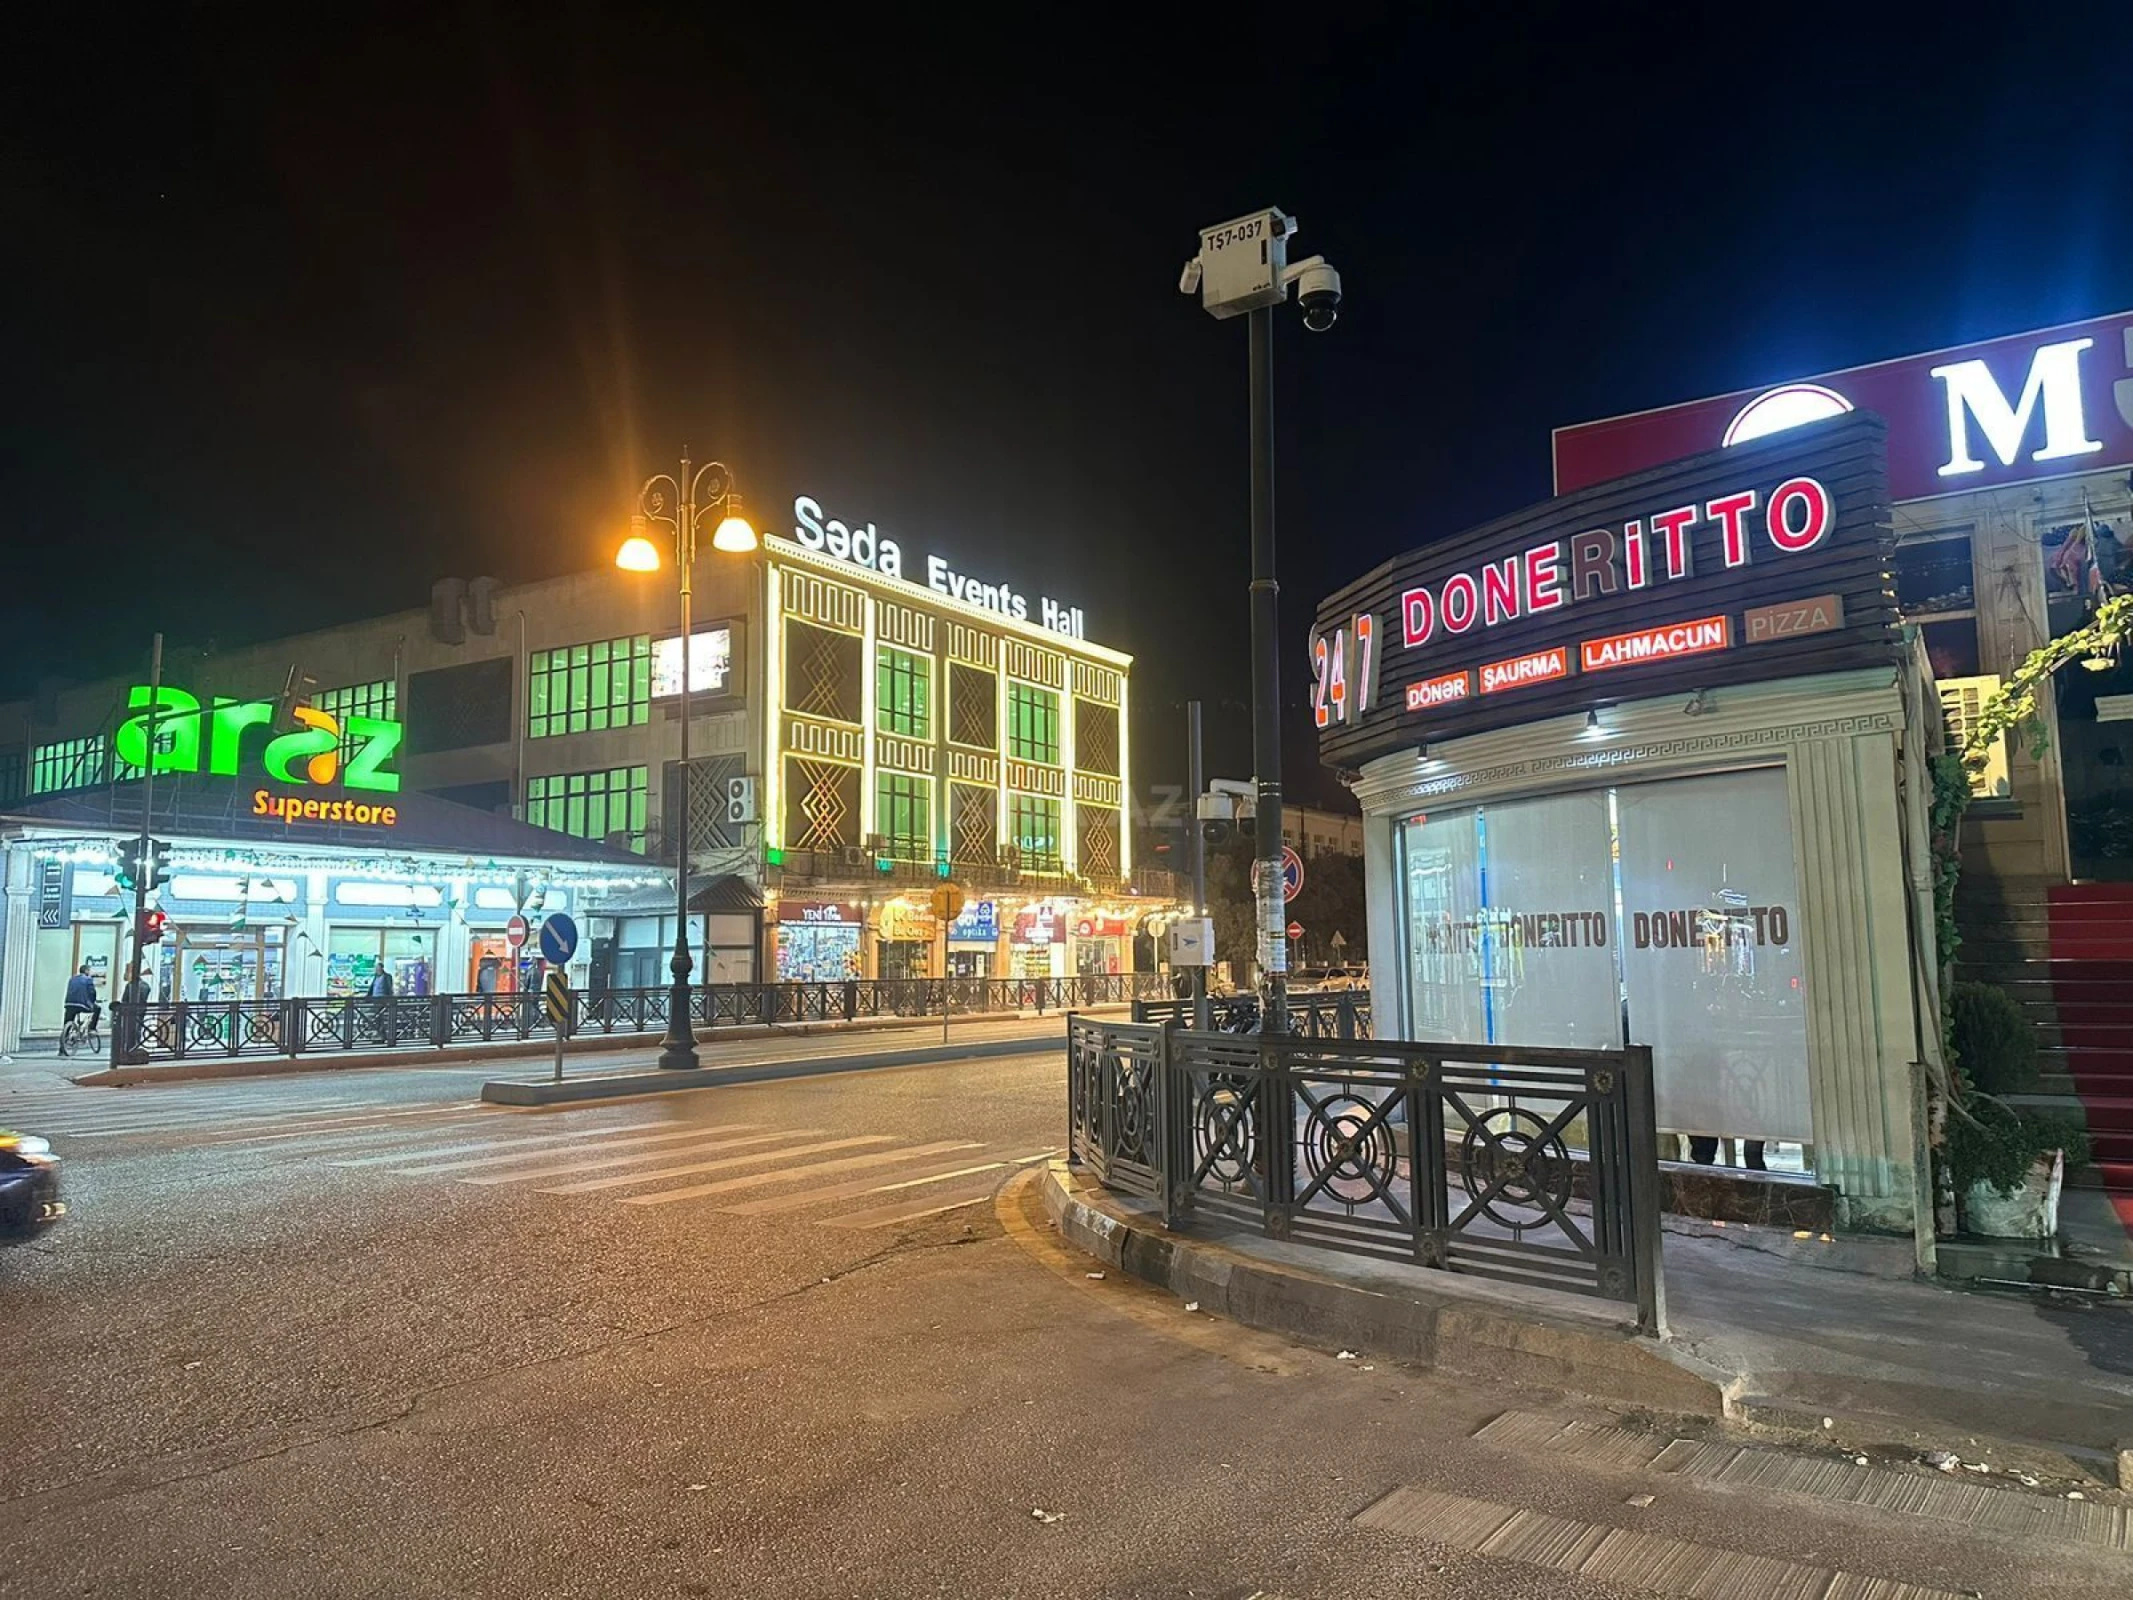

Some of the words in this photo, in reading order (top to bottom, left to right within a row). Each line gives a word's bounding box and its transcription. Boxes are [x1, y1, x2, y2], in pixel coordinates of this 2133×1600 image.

[793, 494, 903, 579] Səda
[927, 553, 1028, 622] Events
[1040, 595, 1085, 640] Hall
[1585, 624, 1722, 666] LAHMACUN
[1483, 652, 1562, 693] ŞAURMA
[116, 686, 402, 793] araz
[252, 789, 396, 826] Superstore
